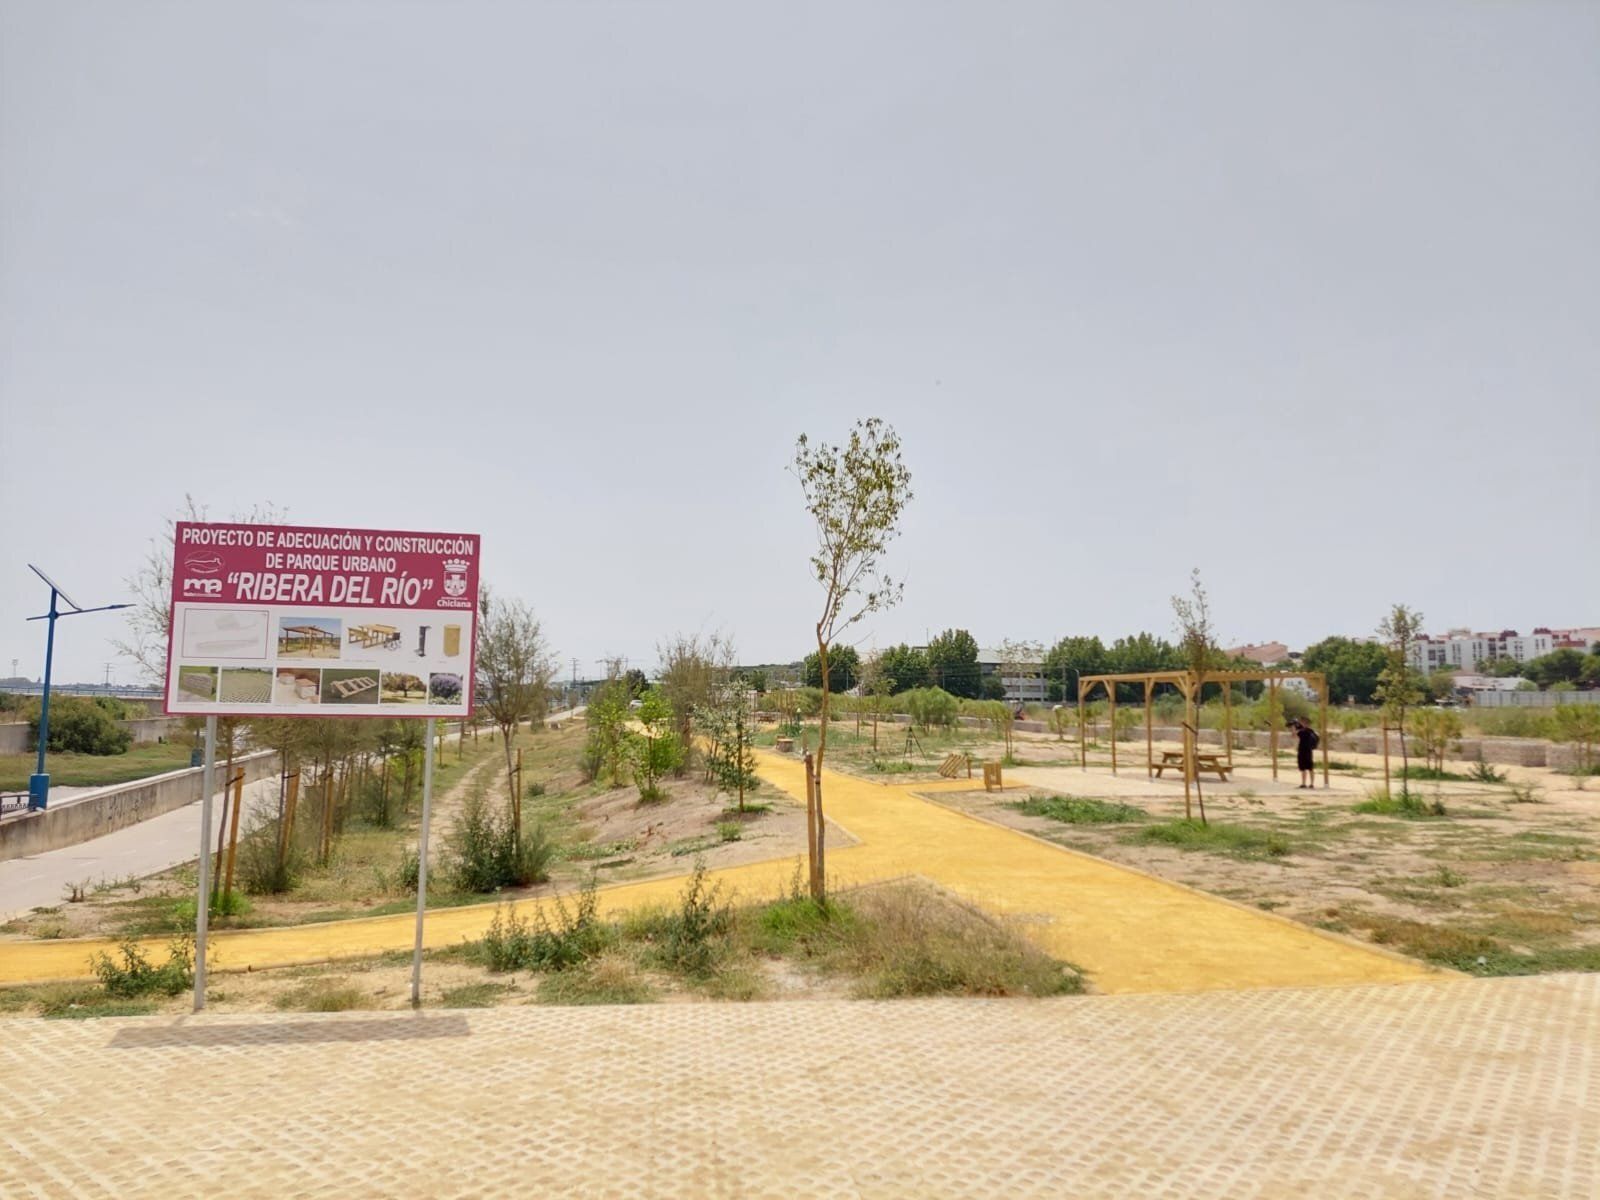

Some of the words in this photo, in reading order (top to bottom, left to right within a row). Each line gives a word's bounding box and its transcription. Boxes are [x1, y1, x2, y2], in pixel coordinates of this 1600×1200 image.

[182, 528, 254, 546] PROYECTO
[256, 531, 274, 547] DE
[277, 531, 361, 552] ADECUACIÓN
[364, 535, 374, 550] Y
[375, 535, 474, 556] CONSTRUCCIÓN
[266, 553, 284, 569] DE
[287, 554, 340, 572] PARQUE
[342, 556, 397, 573] URBANO
[227, 572, 324, 603] “RIBERA
[329, 575, 375, 604] DEL
[380, 570, 434, 606] RÍO”
[436, 599, 472, 608] Chiclana
